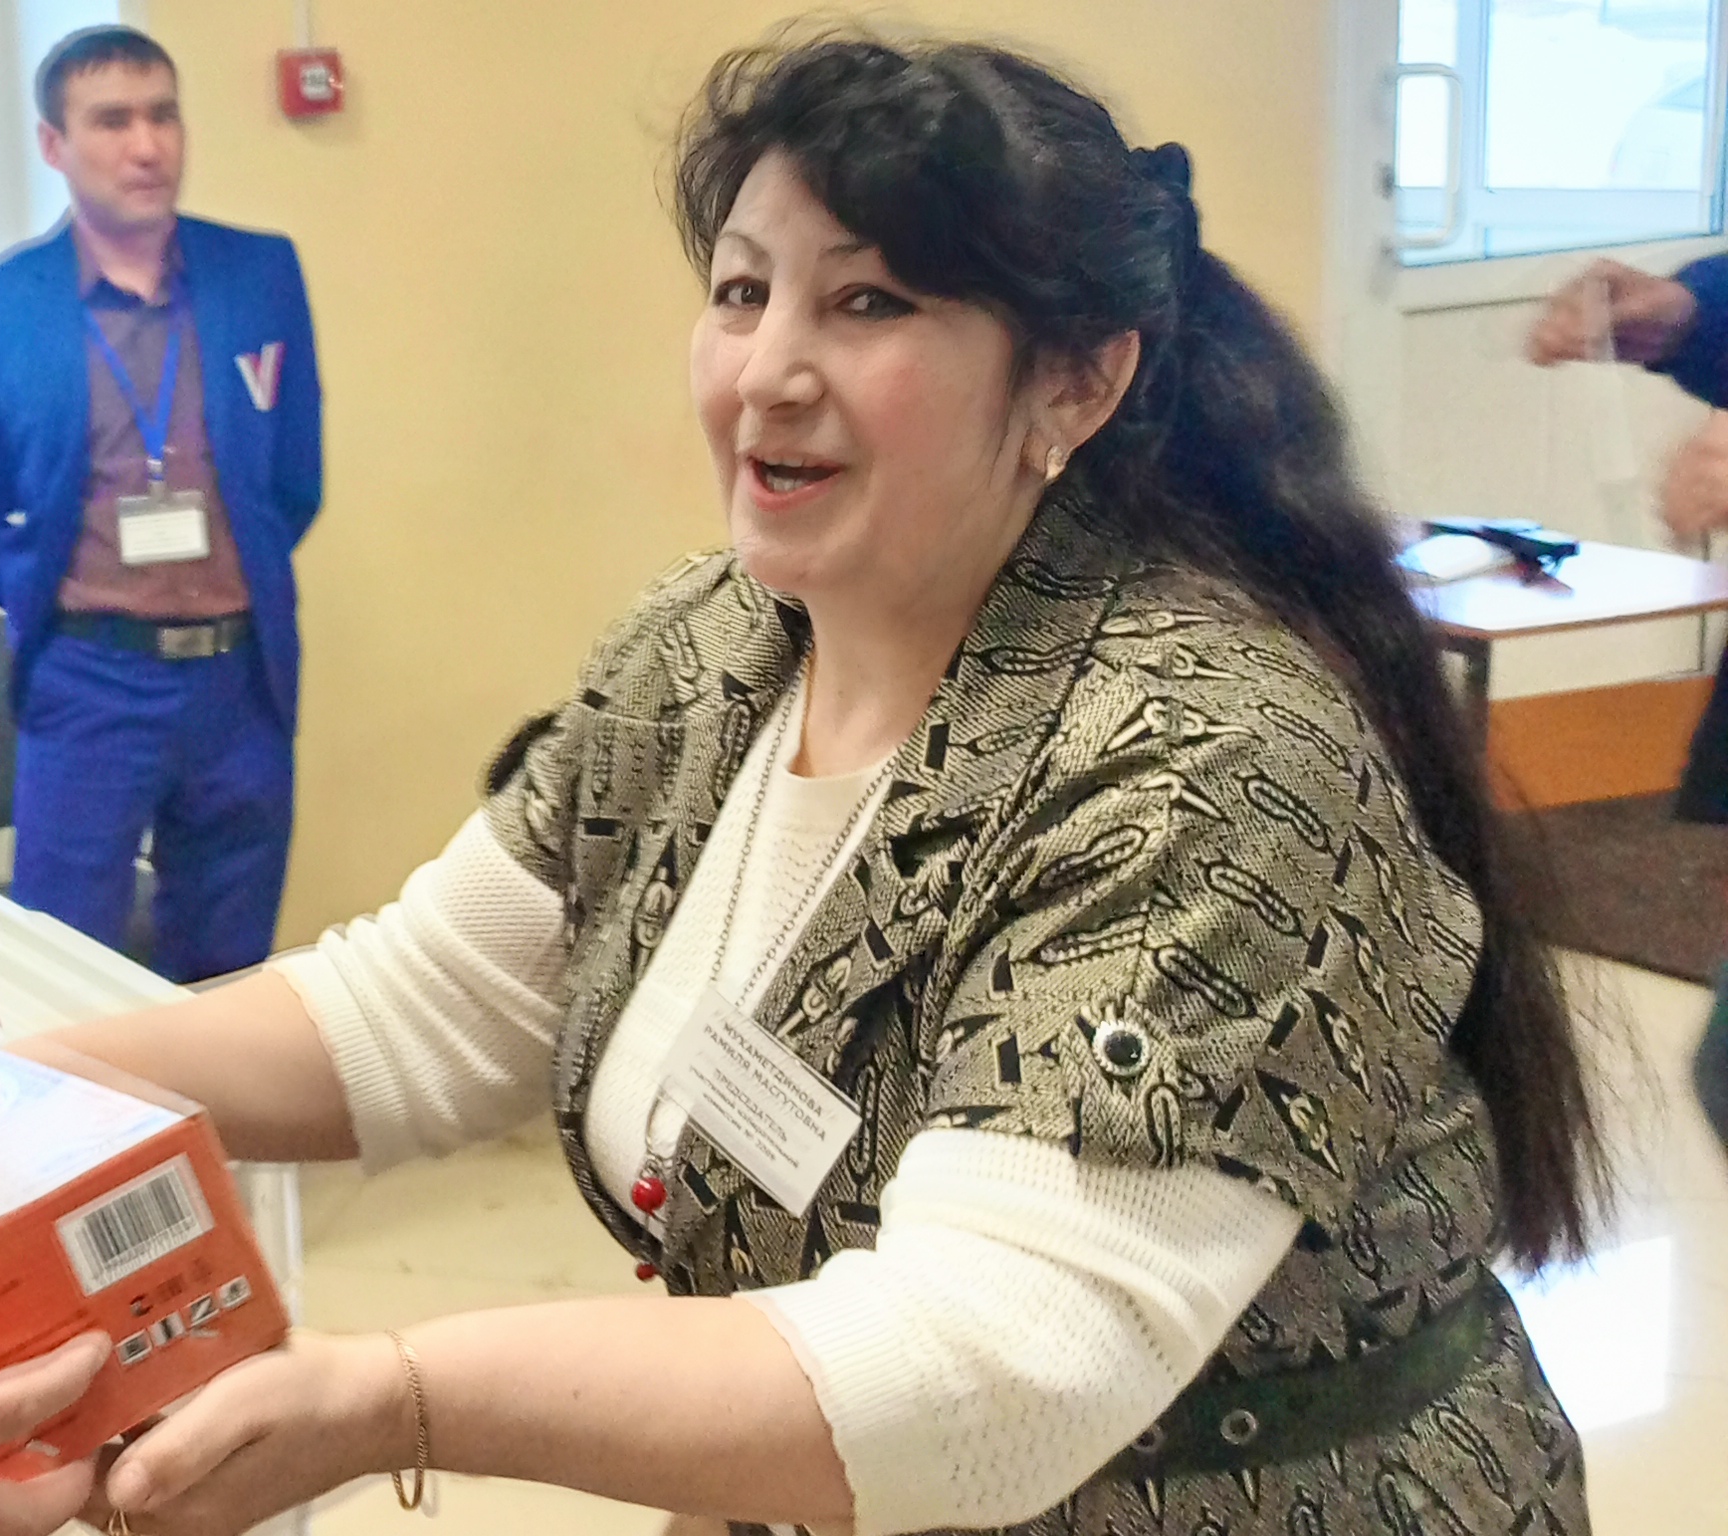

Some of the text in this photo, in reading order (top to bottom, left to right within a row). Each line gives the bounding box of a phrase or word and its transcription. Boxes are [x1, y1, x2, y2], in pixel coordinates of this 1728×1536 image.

[703, 1024, 826, 1141] РАМИЛЯ МАСГУТОВНА
[713, 1067, 788, 1142] ПРЕДСЕДАТЕЛЬ
[724, 1021, 822, 1117] МУХАМЕТДИНОВА
